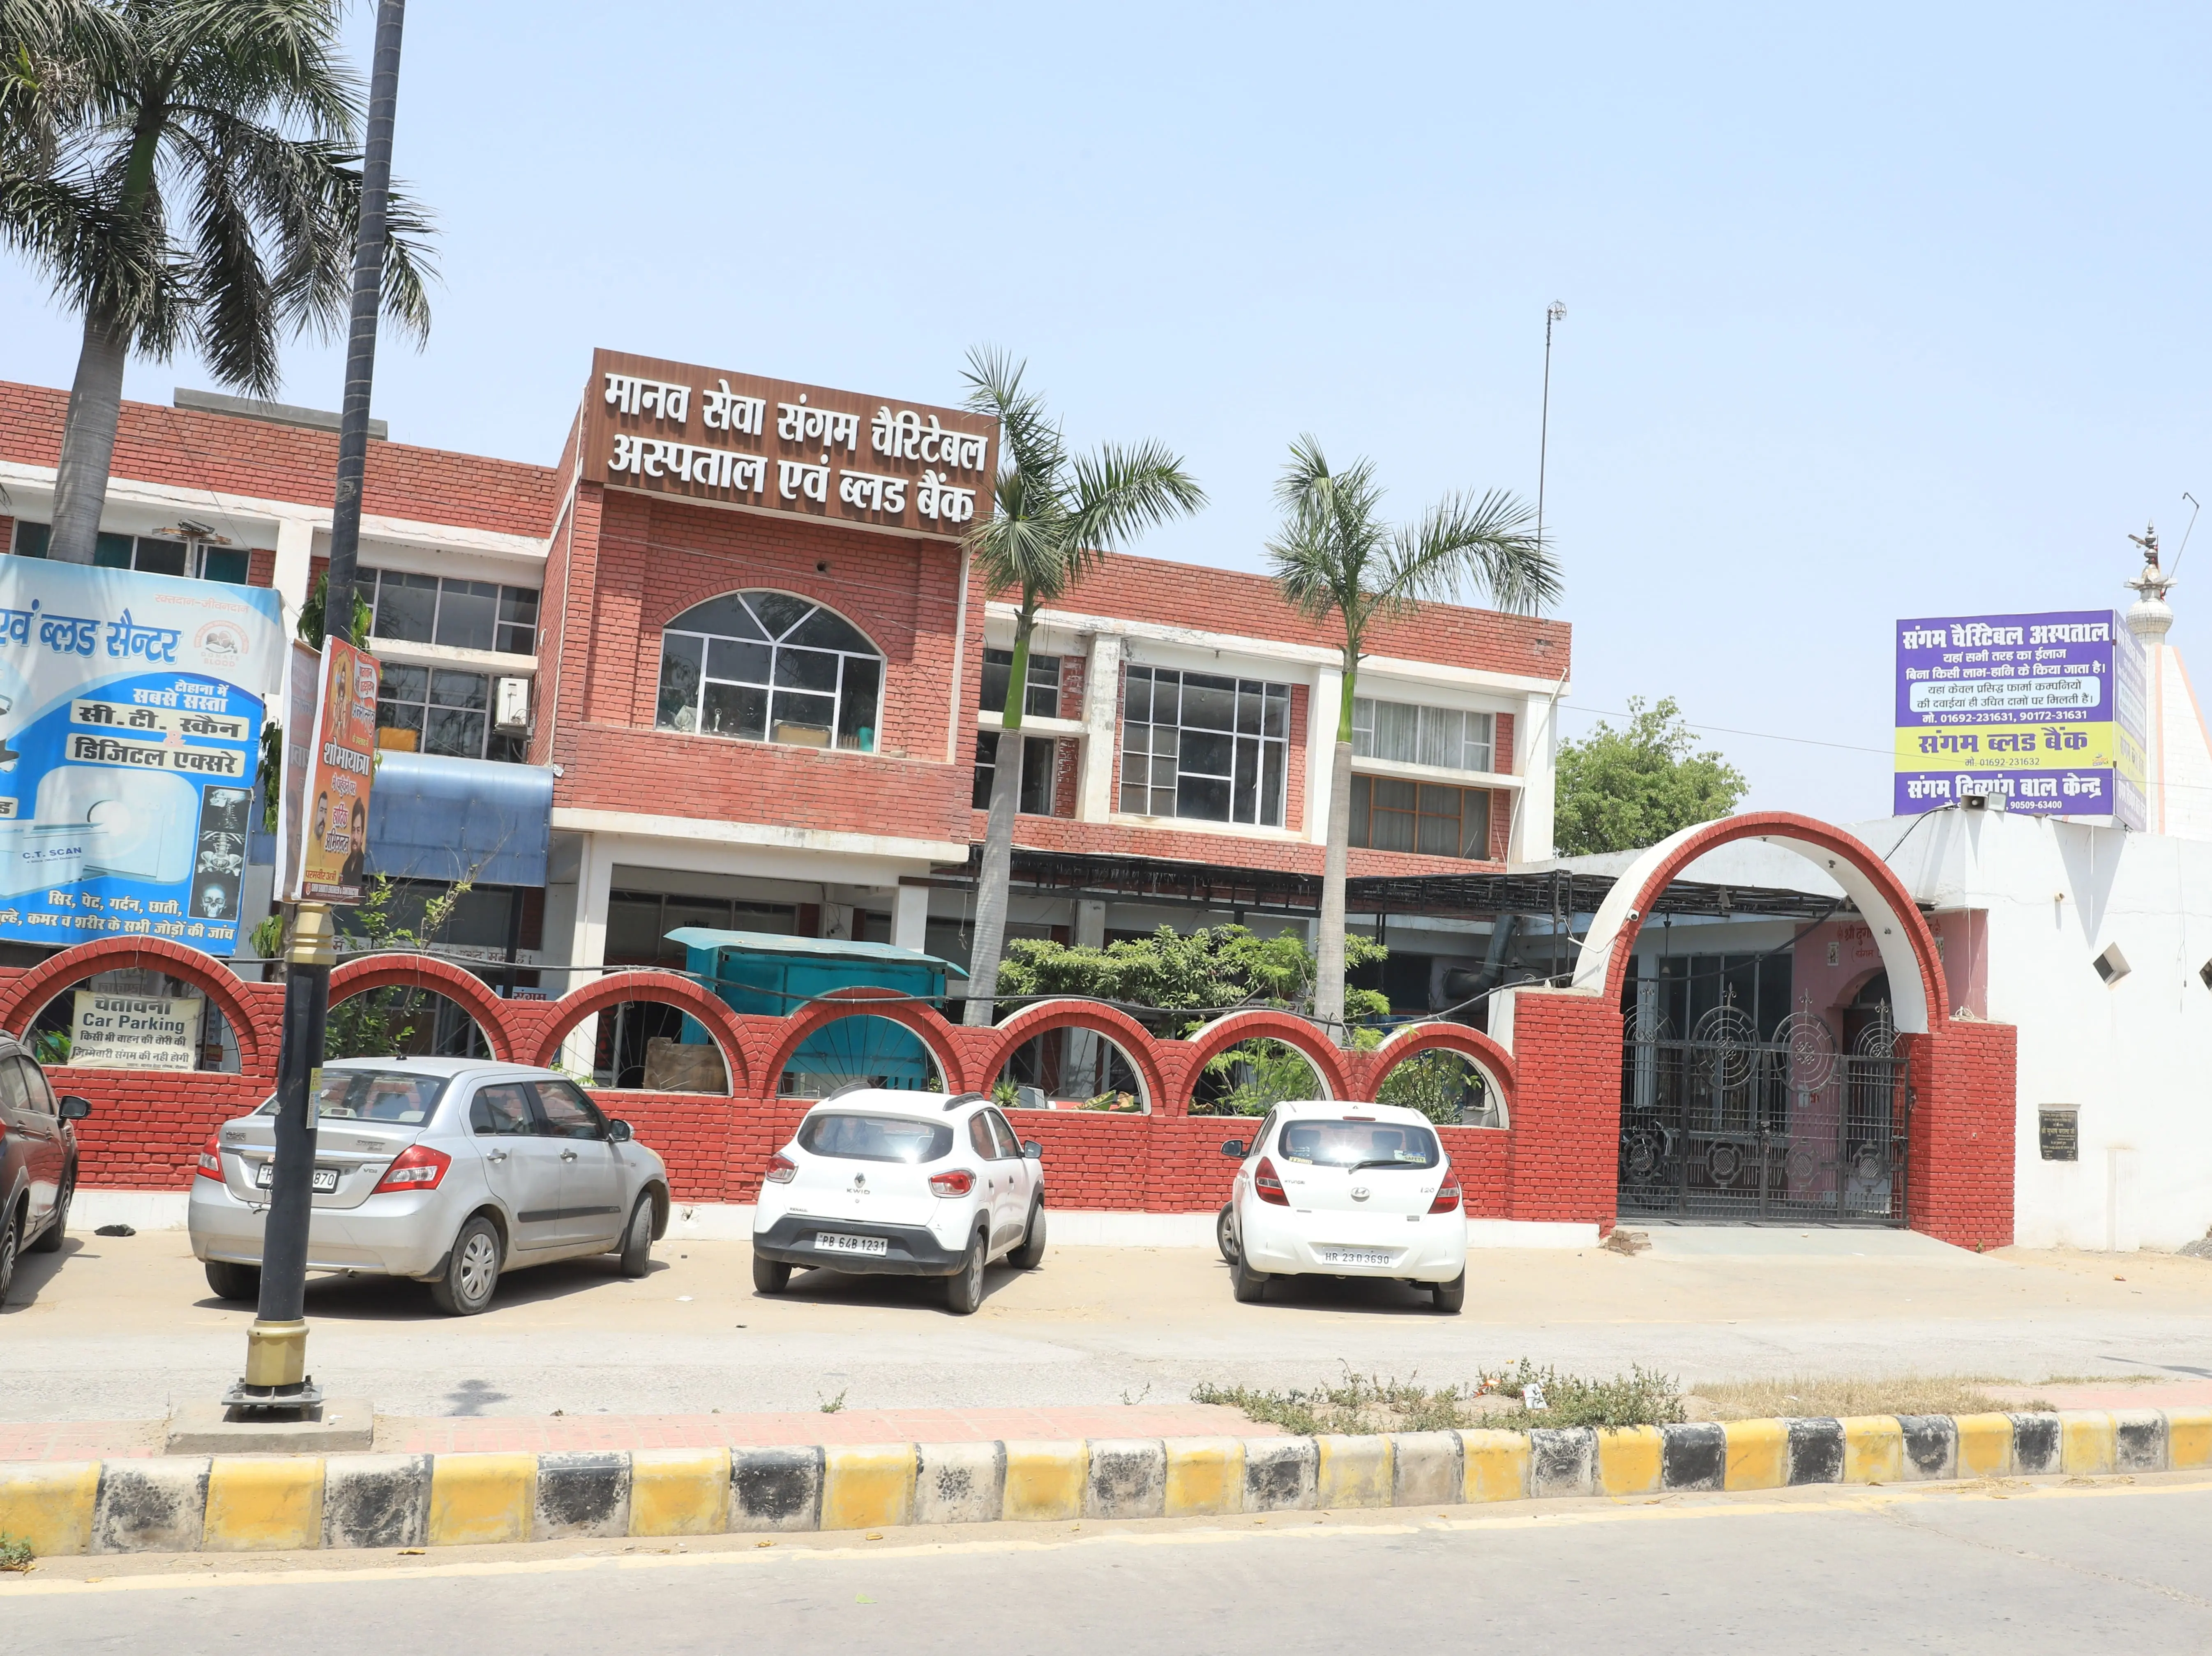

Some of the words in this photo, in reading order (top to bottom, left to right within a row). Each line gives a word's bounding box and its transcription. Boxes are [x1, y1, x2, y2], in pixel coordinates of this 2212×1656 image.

[604, 372, 692, 423] मानव
[702, 378, 766, 436] सेवा
[777, 393, 860, 451] संगम
[871, 406, 988, 471] चैरिटेबल
[608, 434, 768, 493] अस्पताल
[777, 455, 830, 502] एवं
[840, 469, 909, 514] ब्लड
[917, 469, 976, 523] बैंक
[40, 614, 101, 656] ब्लड
[107, 609, 182, 664] सैन्टर
[1903, 625, 1947, 650] संगम
[1950, 623, 2023, 648] चैरिटेबल
[2030, 623, 2110, 644] अस्पताल
[204, 659, 236, 667] BLOOD
[1943, 652, 1964, 663] यहां
[1966, 650, 1988, 662] सभी
[1992, 651, 2014, 662] तरह
[2016, 650, 2032, 661] का
[2035, 647, 2067, 660] ईलाज
[1906, 669, 1929, 680] बिना
[1932, 667, 1960, 679] किसी
[1963, 665, 2015, 678] लाभ-हानि
[2018, 664, 2030, 676] के
[2033, 664, 2061, 676] किया
[2064, 663, 2089, 675] जाता
[2092, 661, 2106, 674] है।
[175, 680, 214, 696] टोहाना
[217, 685, 229, 697] में
[1928, 684, 1945, 695] यहां
[1948, 682, 1974, 694] केवल
[1977, 683, 2004, 695] प्रसिद्ध
[2007, 680, 2032, 692] फार्मा
[2035, 679, 2081, 692] कम्पनियों
[133, 688, 178, 706] सबसे
[184, 694, 228, 713] सस्ता
[1917, 698, 1930, 709] की
[1933, 697, 1965, 709] दवाईयां
[1969, 696, 1978, 708] ही
[1981, 696, 2004, 707] उचित
[2007, 694, 2029, 706] दामों
[2032, 696, 2044, 706] पर
[2047, 693, 2079, 705] मिलती
[1922, 712, 1938, 724] मो.
[1940, 711, 2017, 723] 01692-231631,
[2020, 710, 2087, 721] 90172-31631
[180, 715, 242, 738] स्कैन
[1918, 730, 1979, 753] संगम
[1987, 733, 2037, 752] ब्लड
[2041, 727, 2087, 750] बैंक
[75, 737, 168, 766] डिजिटल
[173, 751, 238, 773] एक्सरे
[323, 737, 371, 776] शोभायात्रा
[1965, 757, 1977, 768] मो.
[1980, 757, 2040, 766] 01692-231632
[350, 782, 356, 796] पर
[1908, 775, 1950, 798] संगम
[2020, 777, 2057, 797] बाल
[2062, 773, 2102, 799] केन्द्र
[332, 803, 348, 826] हार्दिक
[2010, 801, 2062, 810] 90509-63400
[325, 828, 350, 853] अभिनन्दन
[23, 851, 46, 859] C.T.
[49, 847, 82, 856] SCAN
[306, 869, 325, 879] परमवीर
[48, 890, 76, 909] सिर,
[82, 893, 104, 911] पेट,
[109, 896, 143, 914] गर्दन,
[148, 899, 183, 916] छाती,
[27, 913, 58, 927] कमर
[62, 916, 72, 928] व
[75, 915, 107, 931] शरीर
[108, 916, 120, 932] के
[124, 918, 151, 934] सभी
[154, 920, 187, 939] जोड़ों
[188, 921, 204, 938] की
[208, 923, 236, 940] जांच
[83, 1013, 113, 1028] Car
[119, 1015, 185, 1035] Parking
[81, 1030, 104, 1042] किसी
[105, 1032, 115, 1042] भी
[117, 1034, 140, 1044] वाहन
[141, 1034, 153, 1044] की
[155, 1035, 173, 1046] चोरी
[174, 1036, 187, 1046] की
[115, 1048, 137, 1060] संगम
[139, 1050, 151, 1061] की
[171, 1052, 189, 1062] होगी
[314, 1173, 334, 1185] 870
[822, 1235, 835, 1247] PB
[839, 1237, 858, 1249] 64B
[862, 1239, 884, 1252] 1231
[1325, 1252, 1338, 1261] HR
[1364, 1255, 1389, 1264] 3690
